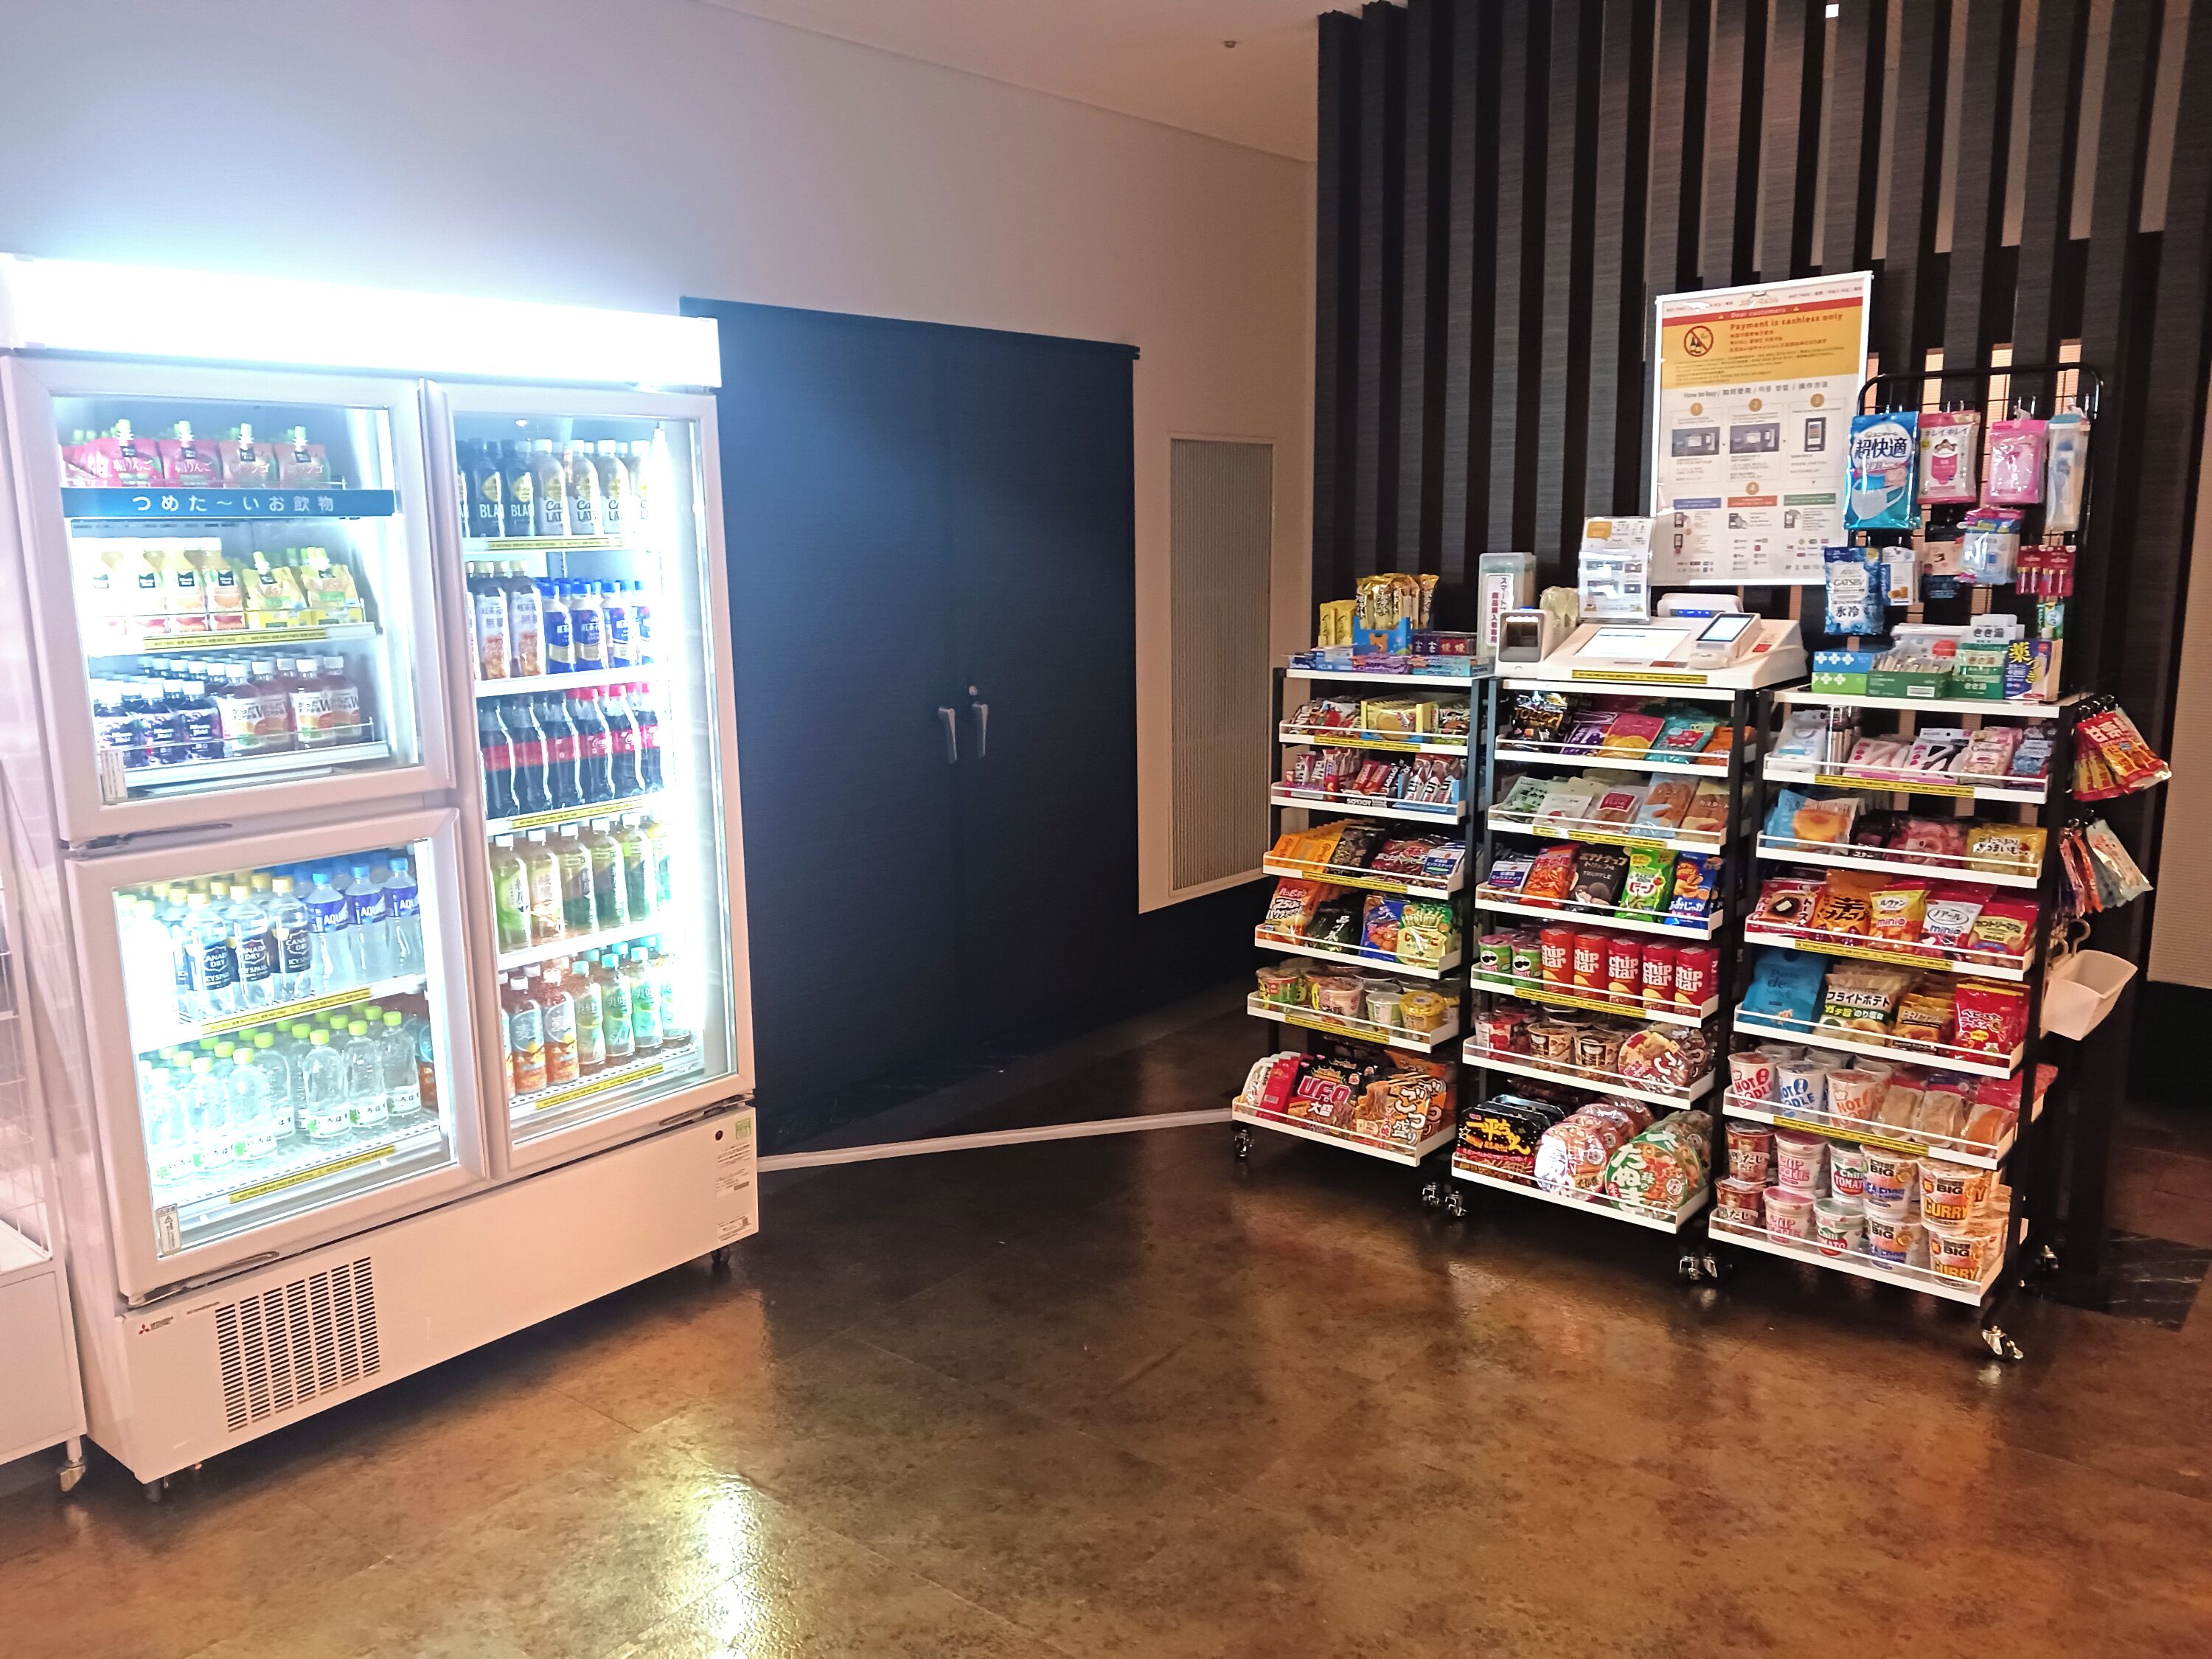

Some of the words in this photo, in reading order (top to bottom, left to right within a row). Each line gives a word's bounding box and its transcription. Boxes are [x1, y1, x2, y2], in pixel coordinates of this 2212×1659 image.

[1748, 307, 1787, 318] customers
[1730, 319, 1769, 330] Payment
[1771, 318, 1779, 327] is
[1781, 316, 1820, 326] cashless
[1823, 313, 1843, 321] only
[1924, 426, 1969, 437] キレイキレイ
[1854, 437, 1908, 459] 超快適
[1834, 577, 1865, 587] GATSBY
[1584, 870, 1612, 880] TRUFFLE
[1933, 909, 1962, 921] ノアール
[1608, 956, 1638, 969] chip
[1608, 966, 1638, 980] star
[1826, 991, 1890, 1007] フライドポテト
[1734, 1078, 1756, 1092] HOT
[1307, 1101, 1335, 1117] 大盛
[1837, 1097, 1861, 1113] HOT
[1870, 1164, 1894, 1177] BIG
[1936, 1183, 1964, 1194] BIG
[1924, 1196, 1969, 1220] CURRY
[1871, 1227, 1894, 1239] BIG
[1944, 1247, 1969, 1257] BIG
